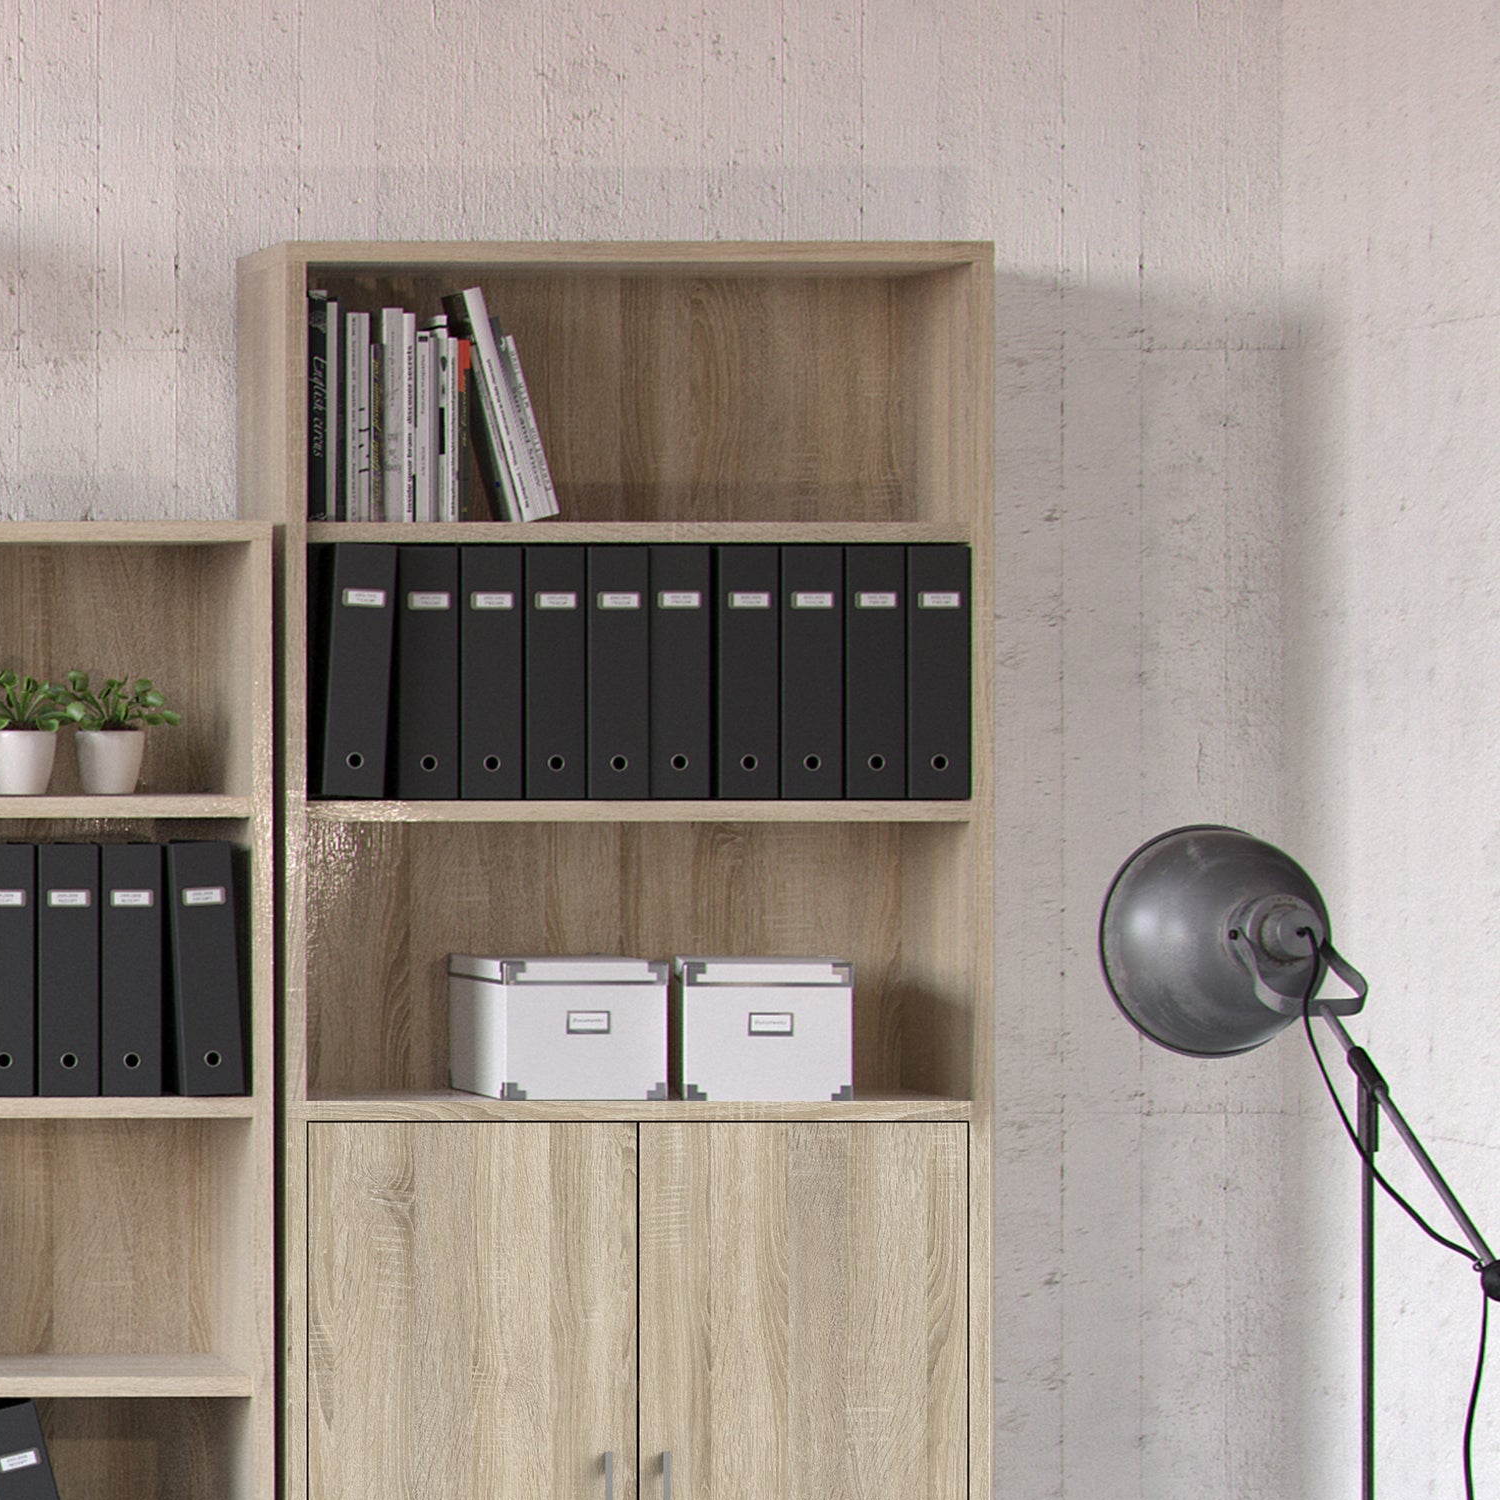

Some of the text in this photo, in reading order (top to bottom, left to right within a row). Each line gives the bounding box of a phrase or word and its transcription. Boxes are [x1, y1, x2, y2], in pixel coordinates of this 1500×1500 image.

[309, 355, 327, 457] English circus
[519, 417, 530, 443] and
